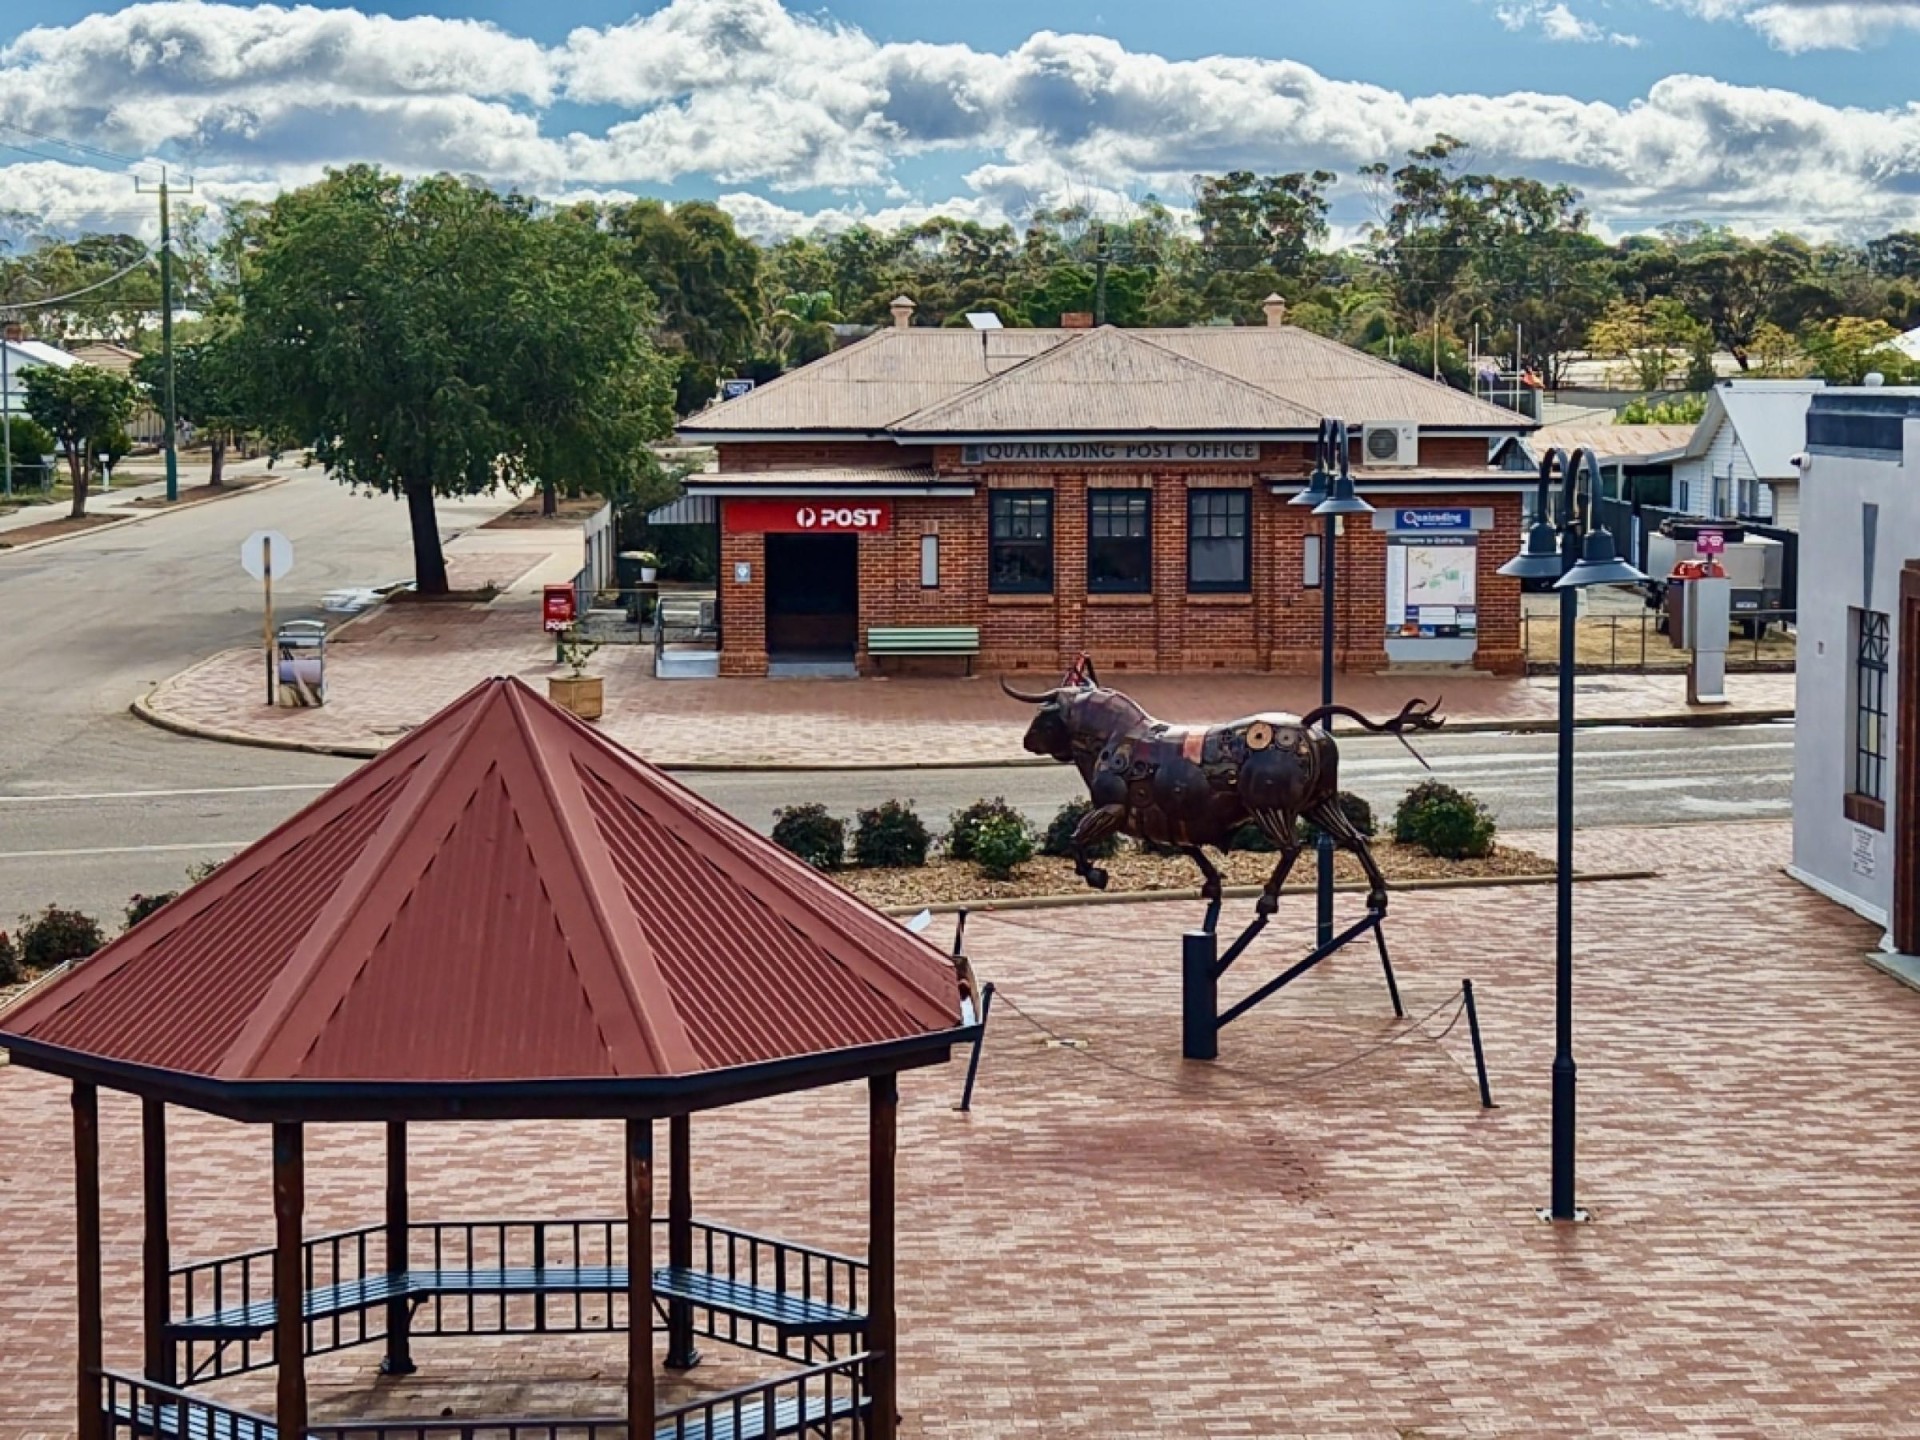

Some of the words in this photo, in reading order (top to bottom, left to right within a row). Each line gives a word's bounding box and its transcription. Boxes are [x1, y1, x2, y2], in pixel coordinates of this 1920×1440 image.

[987, 443, 1115, 459] QUAIRADING
[1126, 443, 1173, 459] POST
[1186, 443, 1255, 459] OFFICE
[820, 508, 882, 527] POST
[1403, 511, 1462, 527] Quairading
